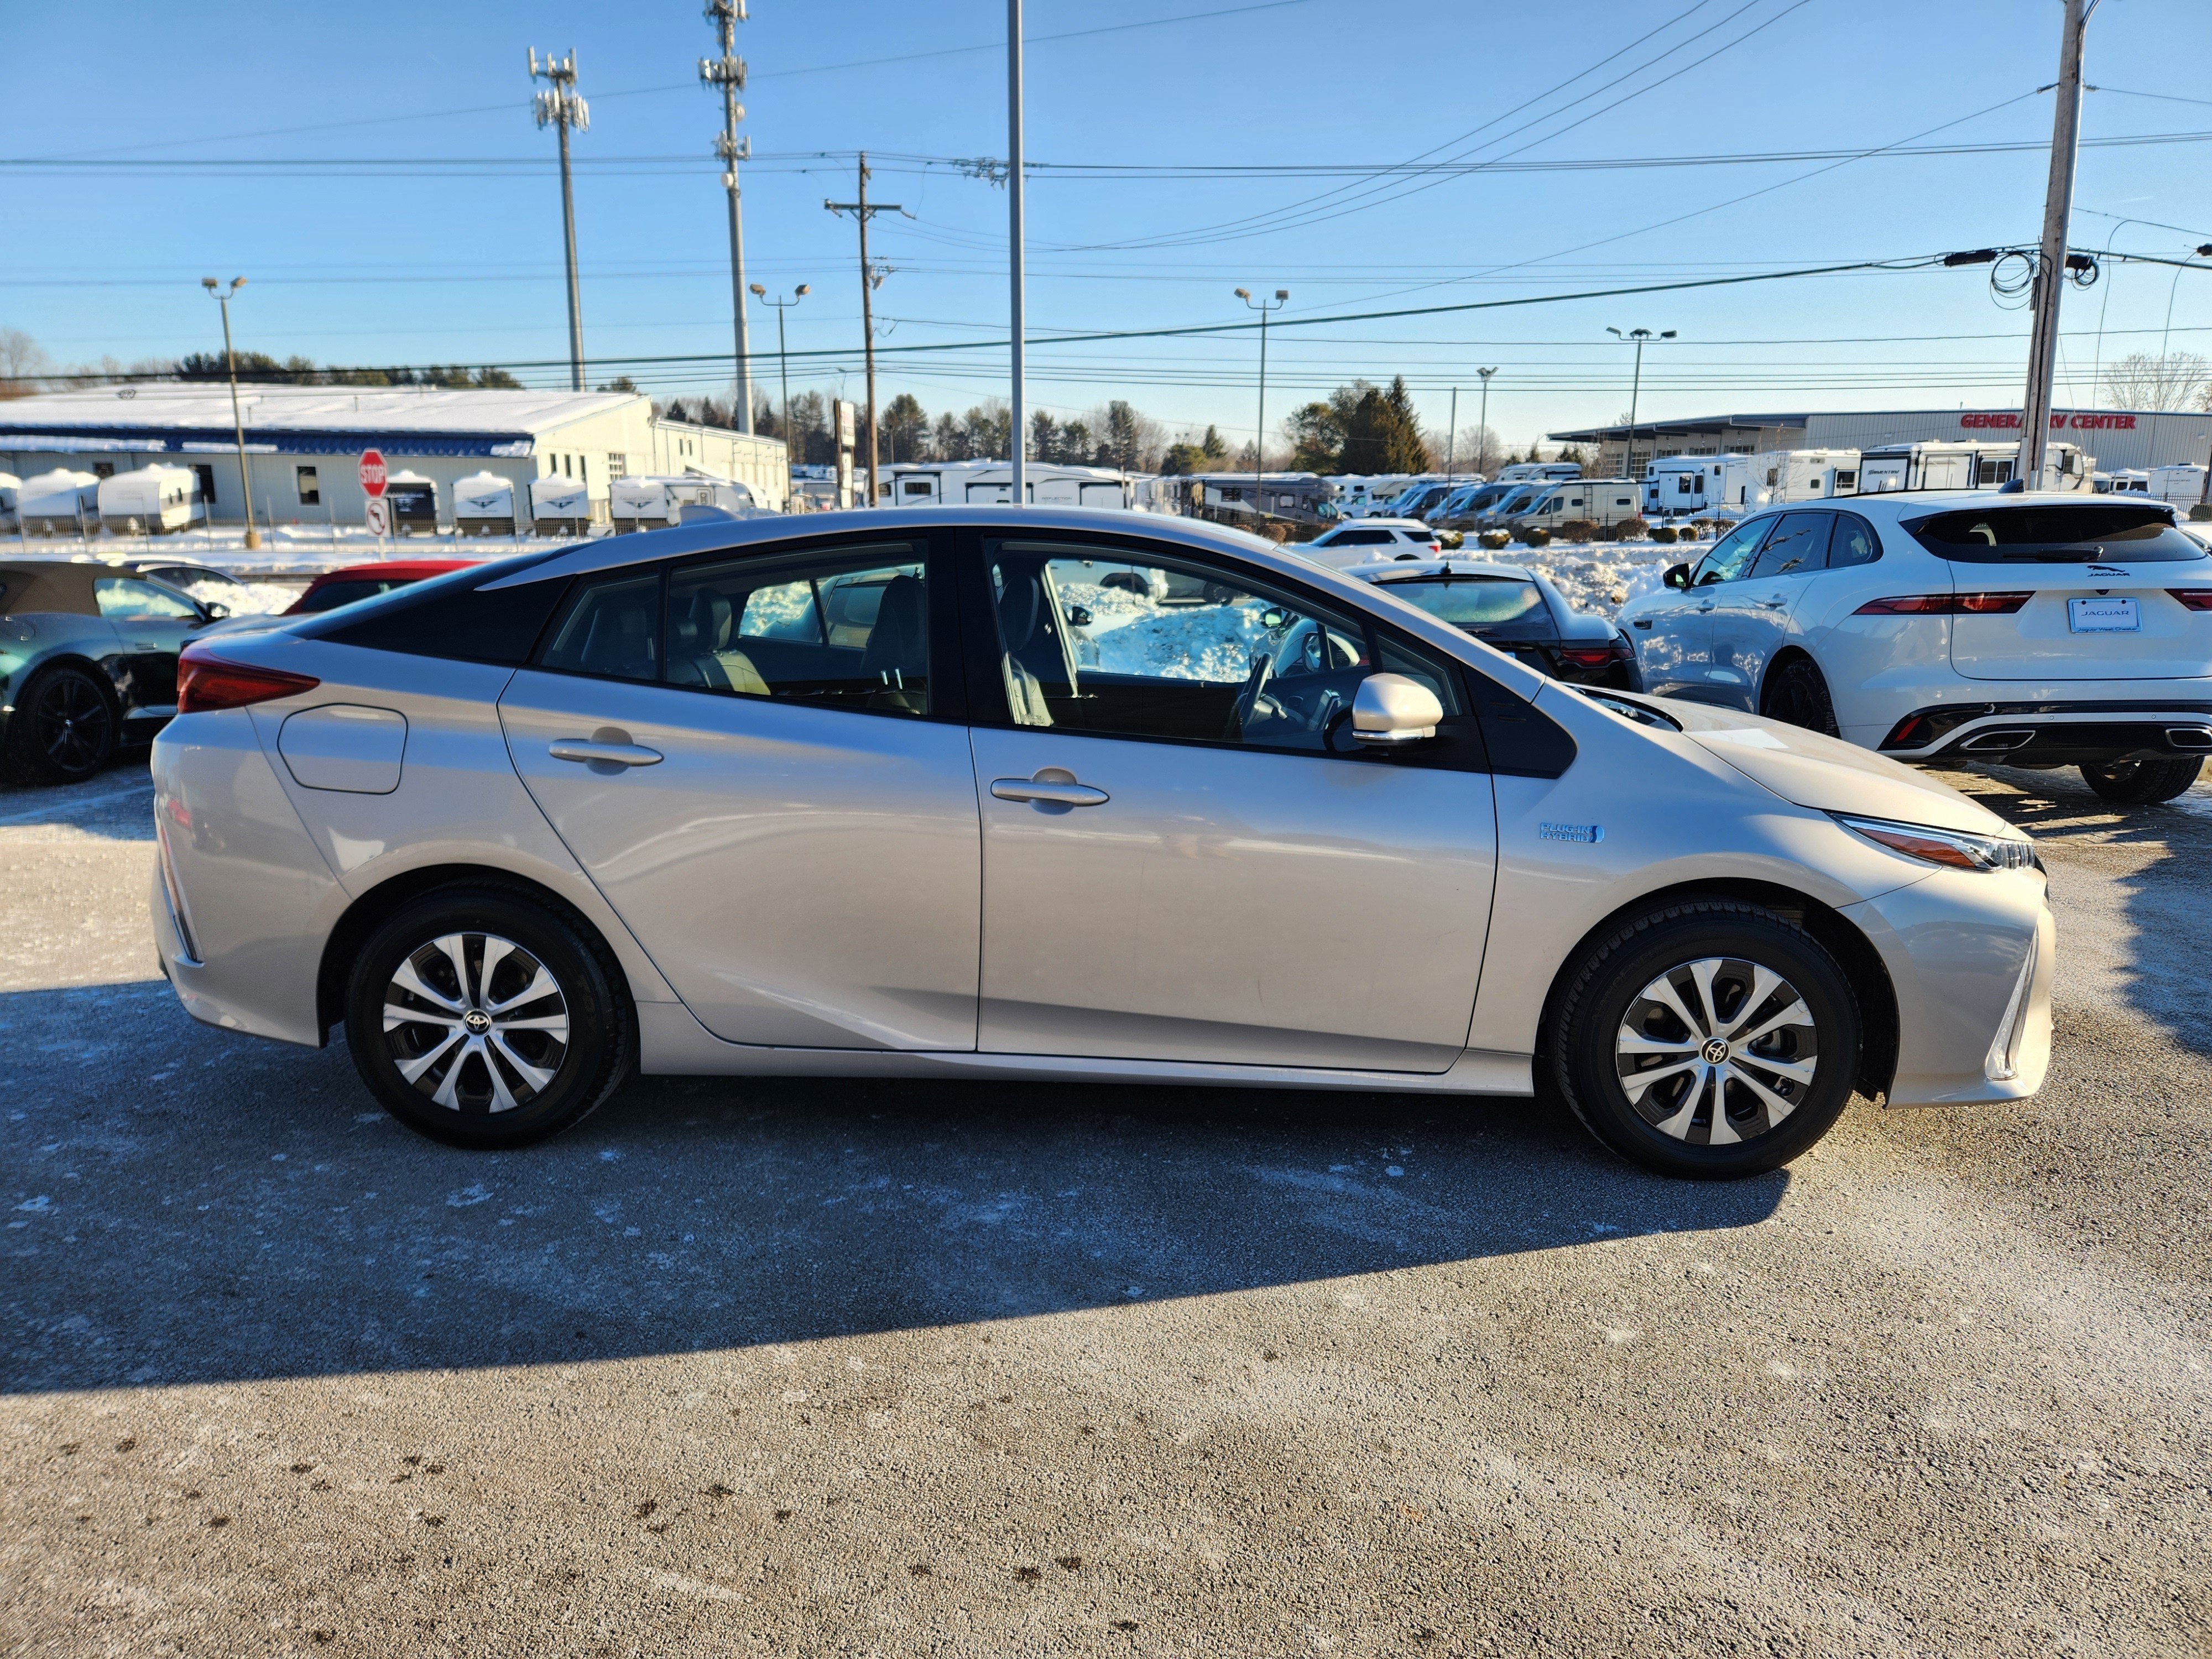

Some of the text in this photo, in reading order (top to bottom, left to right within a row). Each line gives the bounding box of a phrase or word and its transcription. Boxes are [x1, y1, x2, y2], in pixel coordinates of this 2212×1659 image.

[1960, 414, 2022, 429] GENER
[2071, 415, 2136, 430] CENTER
[360, 465, 385, 484] STOP
[1540, 822, 1593, 834] PLUG-IN
[1540, 830, 1591, 843] HYBRID
